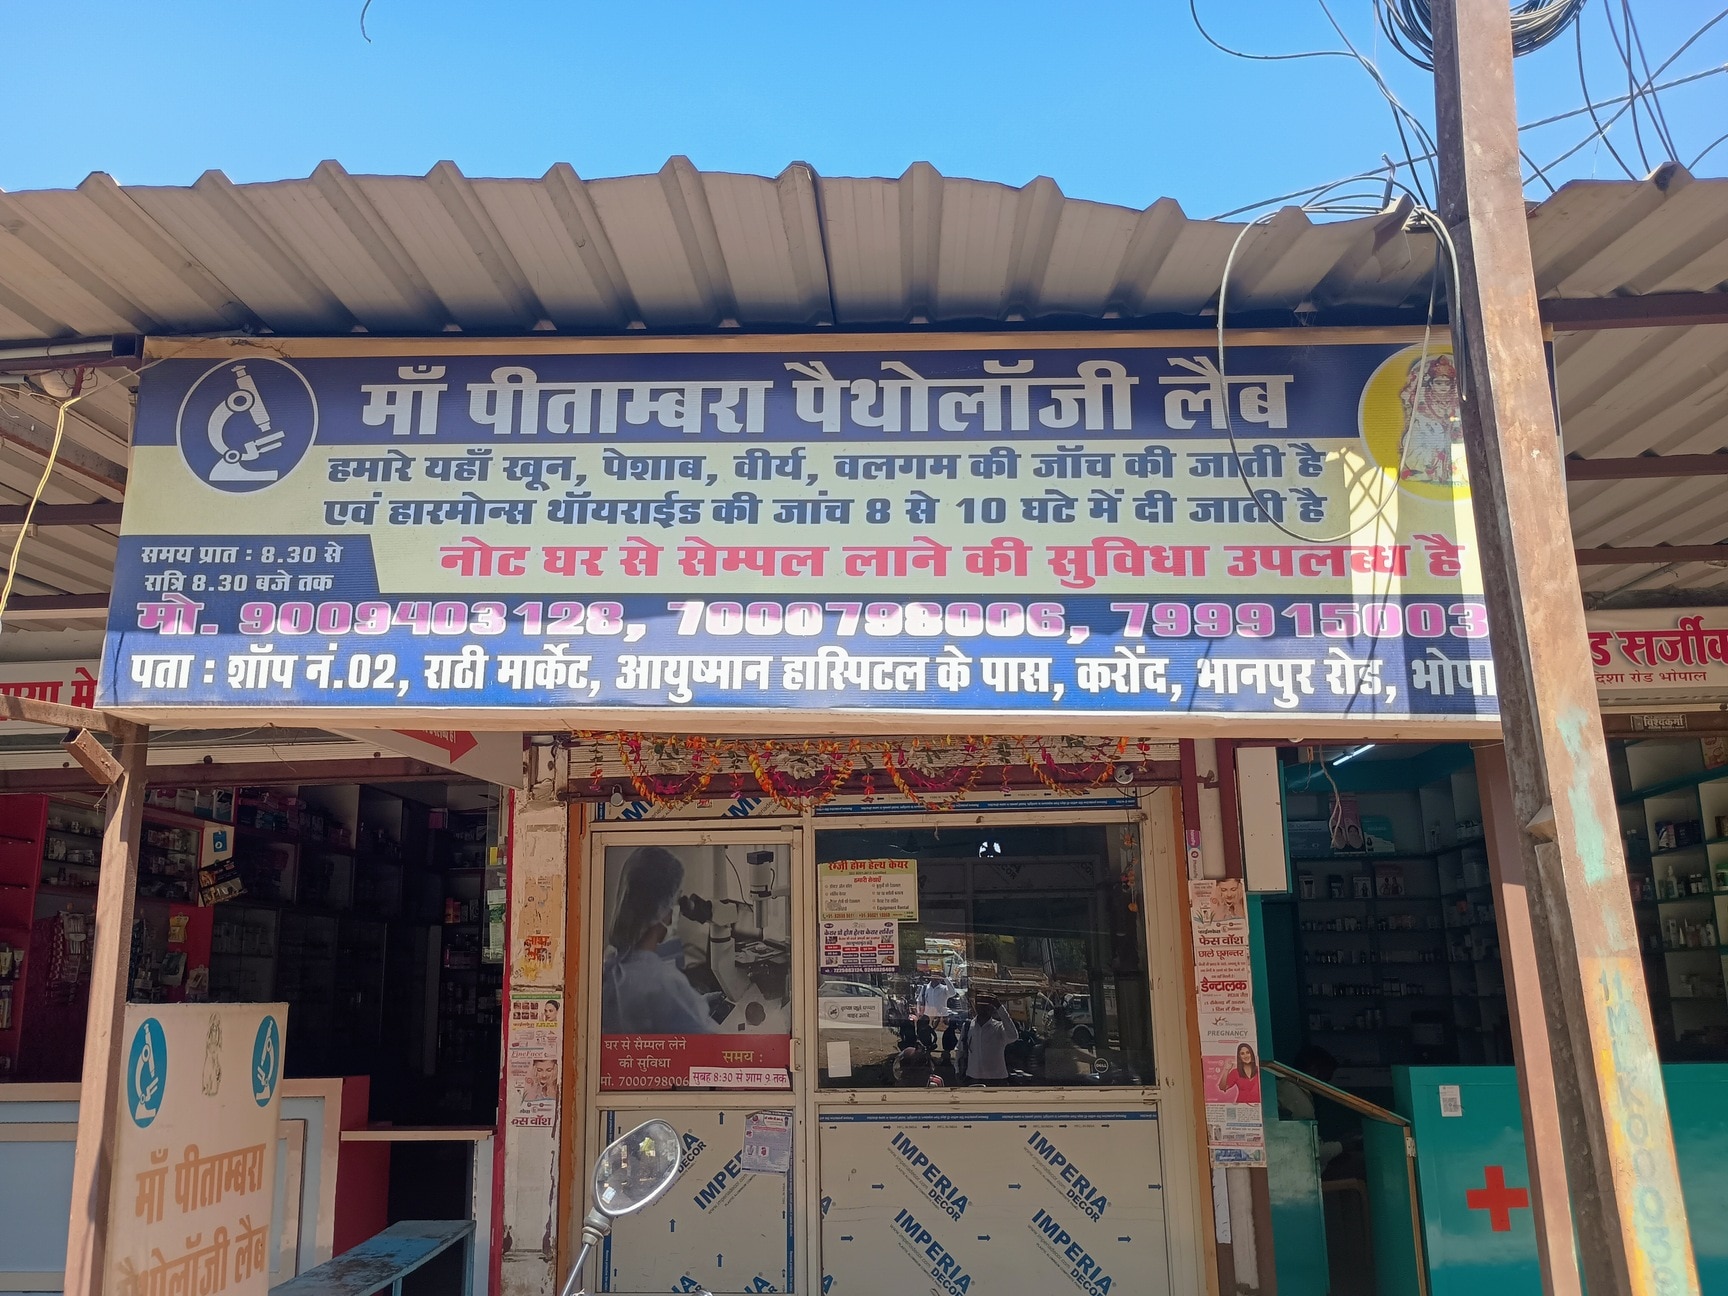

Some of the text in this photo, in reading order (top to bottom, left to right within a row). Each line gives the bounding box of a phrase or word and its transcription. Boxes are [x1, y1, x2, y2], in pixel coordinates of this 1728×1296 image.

[466, 366, 773, 434] पीताम्बरा
[784, 360, 1139, 432] पैथोलॉजी
[1159, 356, 1294, 429] लैब
[328, 449, 416, 482] हमारे
[502, 456, 587, 491] खून,
[602, 447, 718, 486] पेशाब,
[733, 446, 819, 486] वीर्य,
[834, 455, 961, 480] वलगम
[968, 446, 1021, 479] की
[1123, 444, 1177, 478] की
[1187, 444, 1286, 478] जाती
[1287, 443, 1326, 478] है
[324, 487, 1327, 529] एवं हारमोन्स थॉयराईड की जांच 8 से 10 घटे में दी जाती है
[141, 546, 194, 563] समय
[199, 546, 239, 563] प्रात
[261, 546, 316, 563] 8.30
[324, 541, 343, 563] से
[440, 536, 531, 577] नोट
[542, 546, 608, 577] घर
[619, 536, 664, 577] से
[677, 536, 830, 577] सेम्पल
[842, 536, 952, 577] लाने
[962, 536, 1033, 577] की
[1046, 536, 1210, 589] सुविधा
[1413, 534, 1465, 577] है
[144, 569, 334, 592] रात्रि 8.30 बजे तक
[137, 593, 219, 635] मो.
[239, 601, 646, 642] 9009403128,
[667, 602, 1090, 644] 7000798006,
[131, 653, 195, 689] पता
[227, 643, 298, 689] शॉप
[306, 642, 409, 697] नं.02,
[424, 644, 489, 689] राठी
[497, 643, 600, 698] मार्केट,
[616, 654, 773, 703] आयुष्मान
[782, 645, 930, 691] हास्पिटल
[936, 645, 972, 691] के
[980, 657, 1065, 701] पास,
[1075, 646, 1182, 702] करोंद,
[1197, 658, 1315, 708] भानपुर
[1323, 647, 1397, 704] रोड,
[1412, 647, 1497, 695] भोपा
[1629, 669, 1653, 682] रोड
[1658, 669, 1707, 682] भोपाल
[1199, 933, 1244, 946] फेस वॉश
[604, 1036, 687, 1050] घर से सैम्पल लेने
[618, 1054, 672, 1072] की सुविधा
[722, 1050, 755, 1063] समय
[618, 1076, 689, 1087] 7000798006
[692, 1071, 712, 1084] सुबह
[713, 1071, 733, 1083] 8:30
[735, 1069, 744, 1082] से
[745, 1071, 762, 1083] शाम
[773, 1073, 787, 1083] तक
[529, 1114, 551, 1126] वॉश
[175, 1143, 266, 1214] पीताम्बरा
[693, 1149, 743, 1210] IMPE
[890, 1131, 969, 1214] IMPERIA
[1027, 1130, 1108, 1215] IMPERIA
[928, 1188, 962, 1222] DECOR
[1066, 1188, 1101, 1223] DECOR
[234, 1214, 269, 1284] लैब
[893, 1208, 972, 1295] IMPERIA
[1031, 1208, 1113, 1296] IMPERIA
